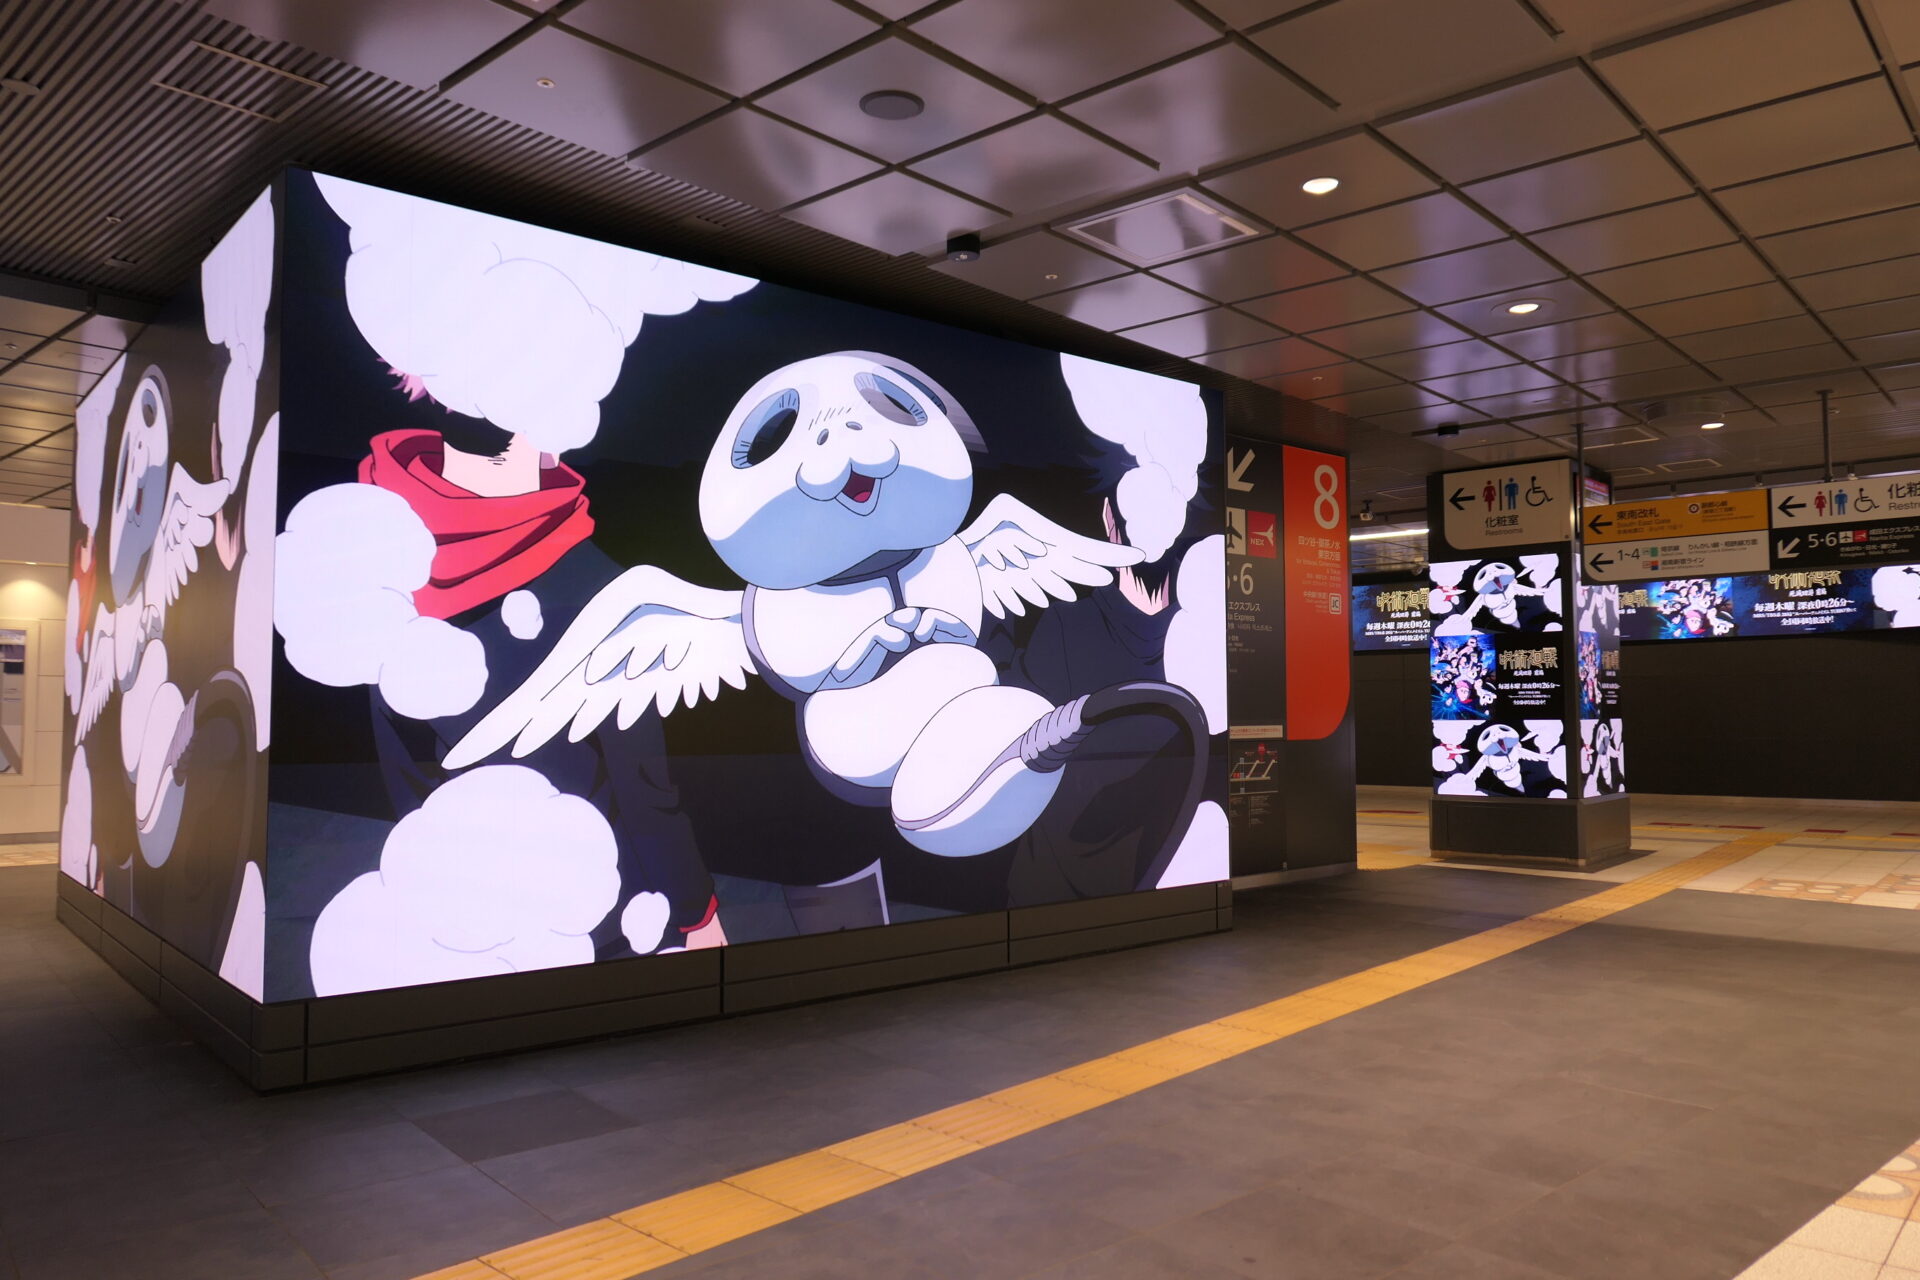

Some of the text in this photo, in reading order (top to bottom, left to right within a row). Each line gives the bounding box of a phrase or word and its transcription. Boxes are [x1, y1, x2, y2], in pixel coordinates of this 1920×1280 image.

[1314, 464, 1340, 530] 8
[1888, 500, 1920, 511] Restr
[1485, 514, 1519, 528] 化粧室
[1754, 601, 1795, 612] 毎週木曜
[1498, 647, 1559, 670] 呪術廻戦
